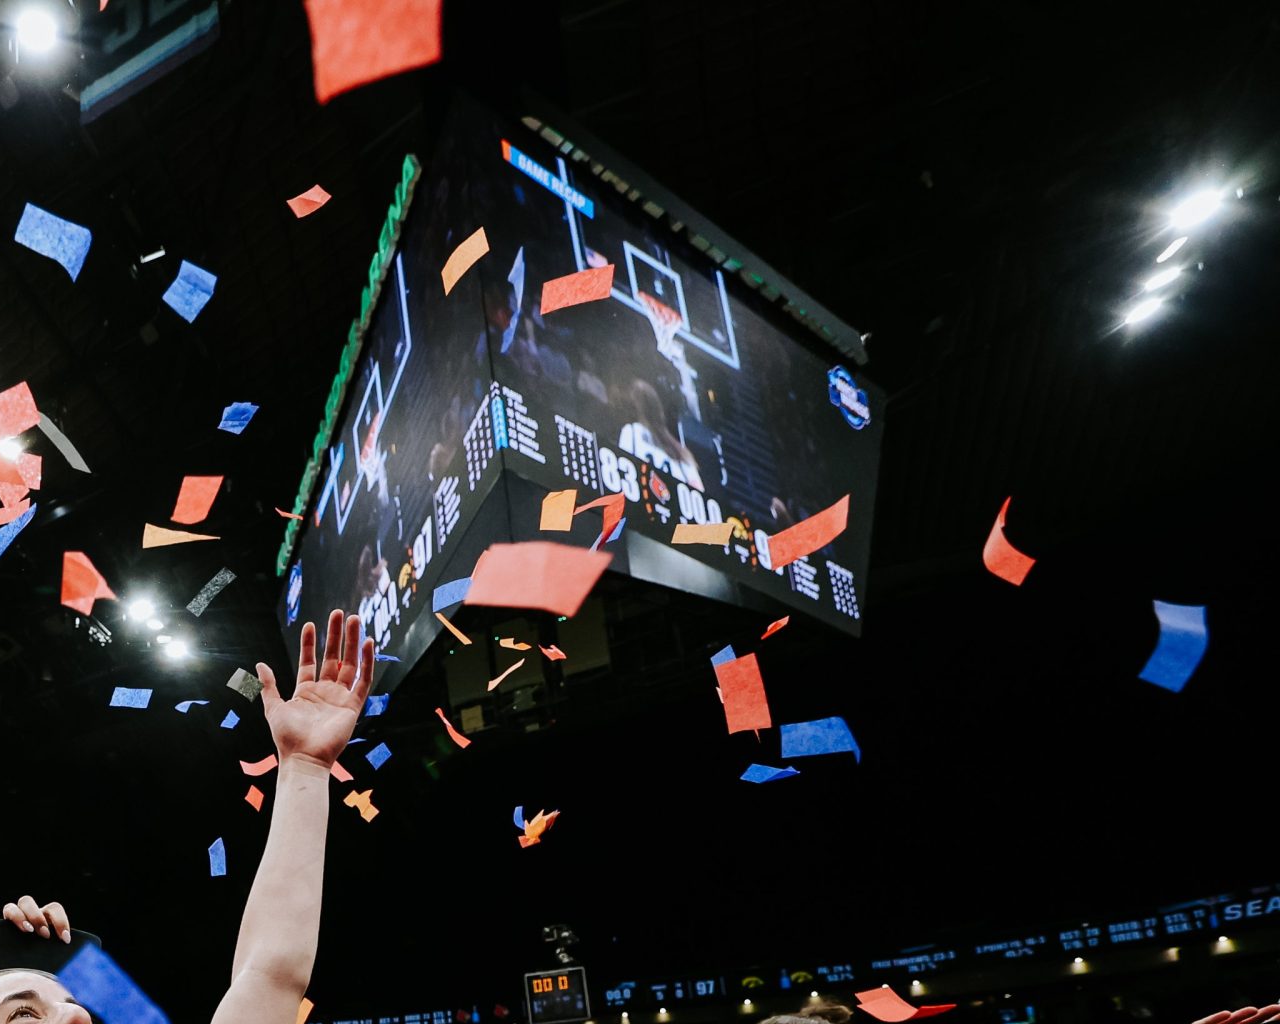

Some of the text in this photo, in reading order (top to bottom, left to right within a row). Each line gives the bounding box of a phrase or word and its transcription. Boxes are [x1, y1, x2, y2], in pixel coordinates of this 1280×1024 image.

[599, 446, 640, 503] 83
[413, 515, 432, 580] 97
[696, 979, 715, 996] 97
